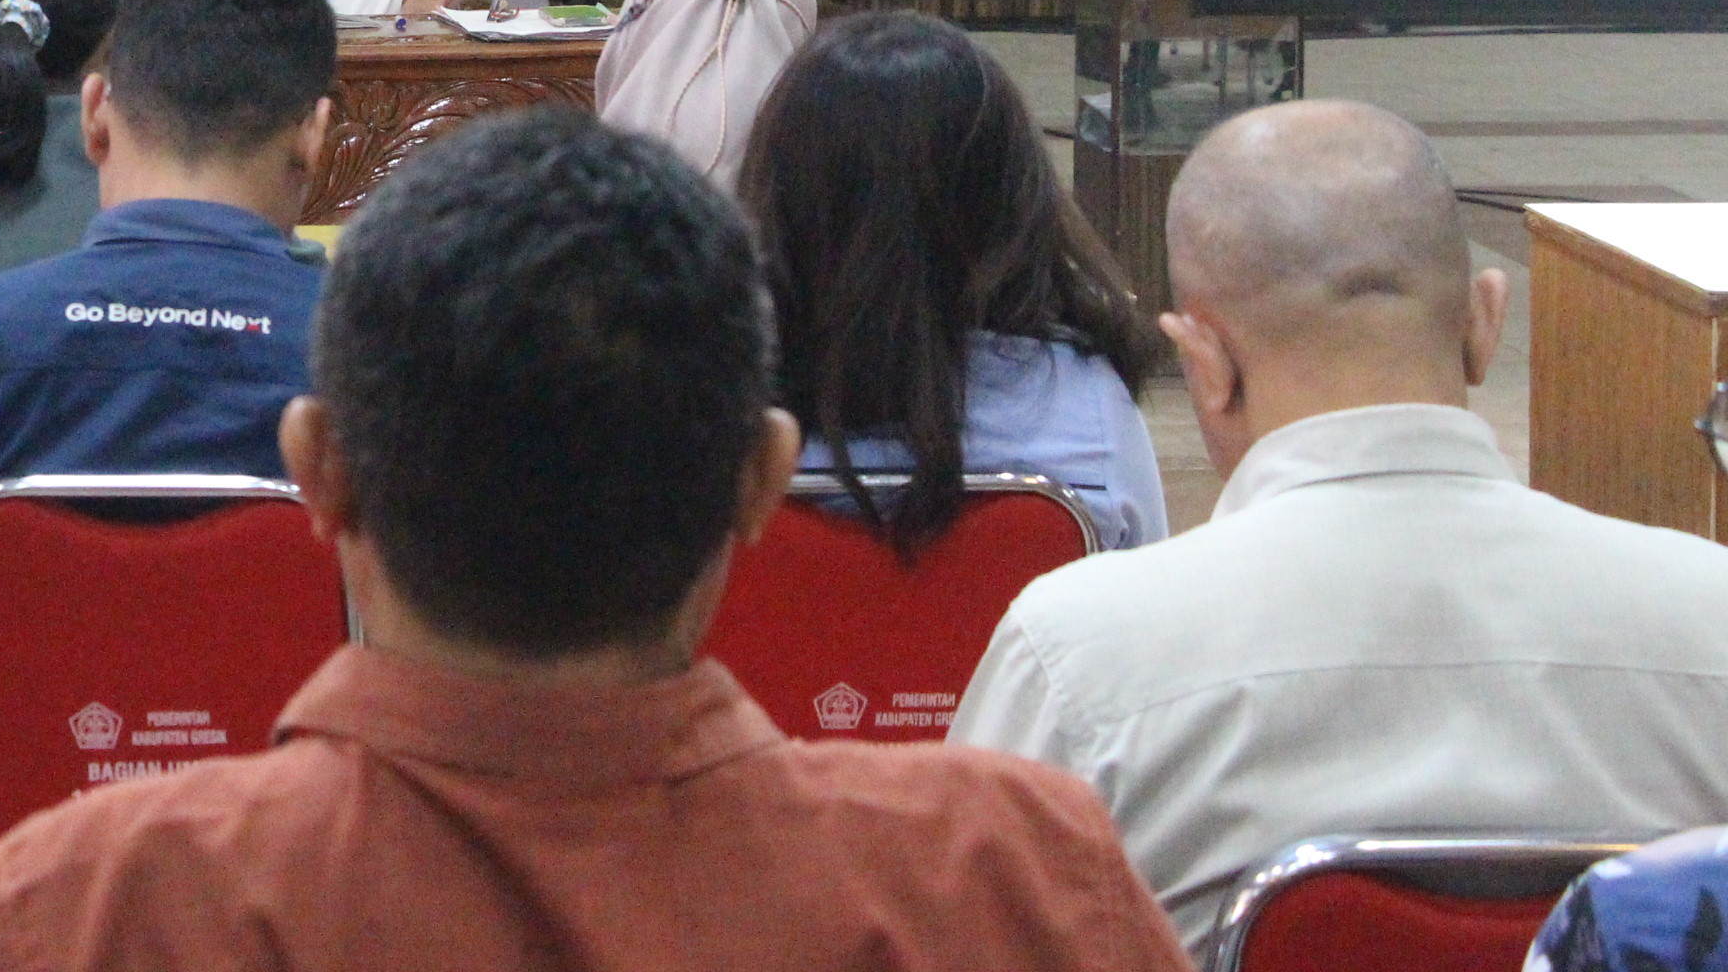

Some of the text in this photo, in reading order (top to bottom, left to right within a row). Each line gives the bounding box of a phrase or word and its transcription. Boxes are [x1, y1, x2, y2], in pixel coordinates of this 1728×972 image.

[65, 303, 272, 335] Go Beyond Next
[891, 692, 957, 708] PEMERINTAH
[875, 712, 932, 727] KABUPATEN
